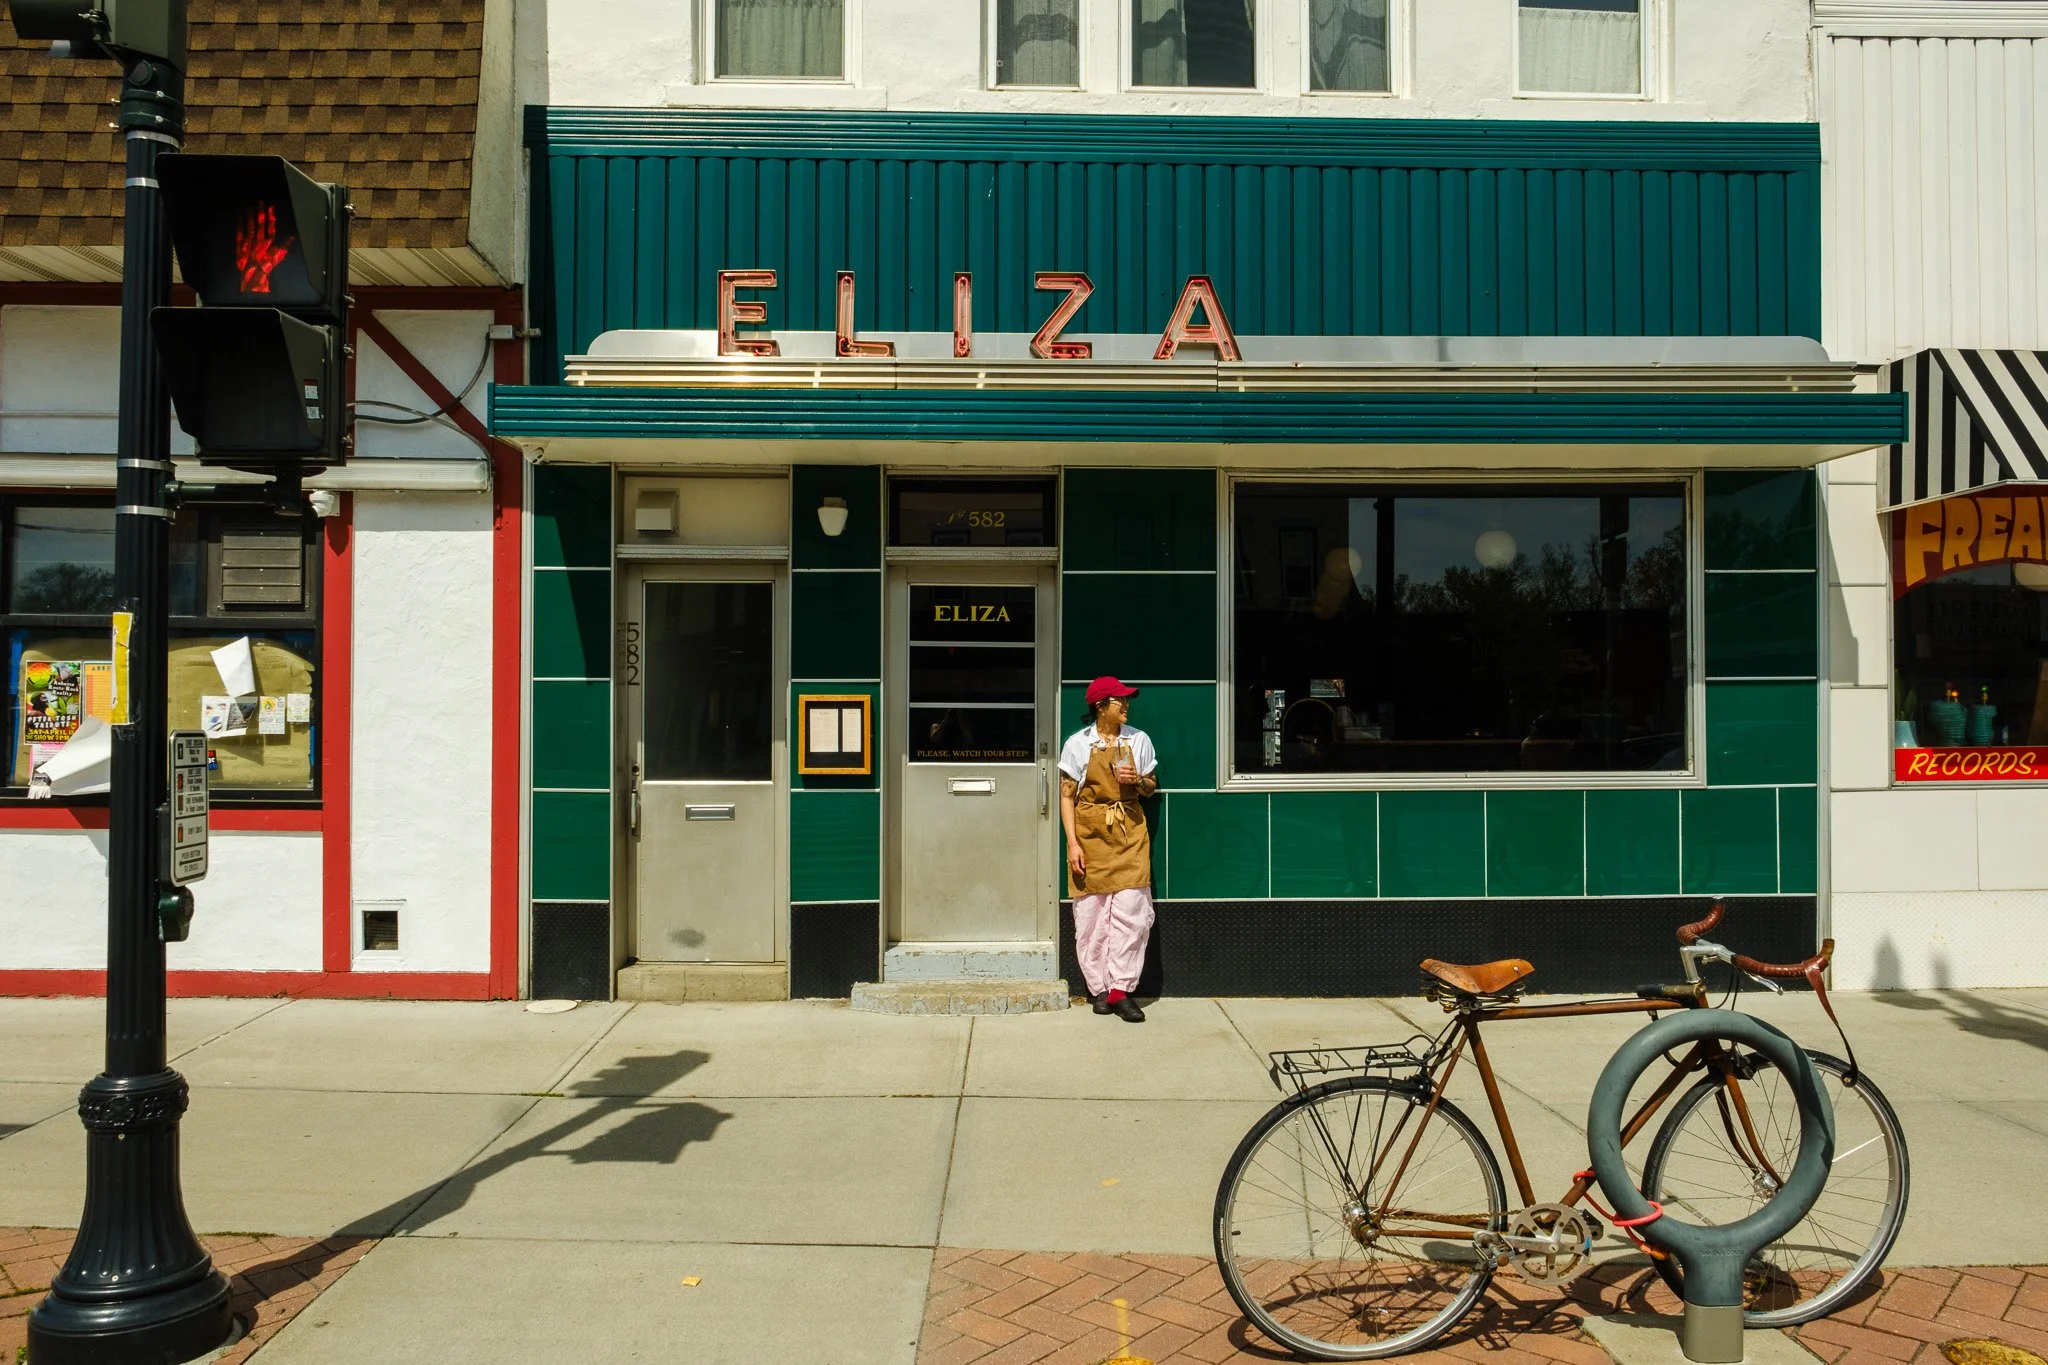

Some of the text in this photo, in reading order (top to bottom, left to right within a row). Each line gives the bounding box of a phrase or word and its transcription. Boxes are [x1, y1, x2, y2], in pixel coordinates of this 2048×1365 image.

[717, 269, 1242, 361] ELIZA
[968, 511, 1004, 527] 582
[1904, 496, 2048, 587] FREA
[934, 604, 1011, 622] ELIZA
[626, 622, 640, 686] 582
[27, 716, 52, 724] PETER
[33, 721, 70, 729] TRIBUTE
[952, 750, 981, 758] WATCH
[983, 750, 1004, 758] YOUR
[1908, 751, 2040, 777] RECORDS.
